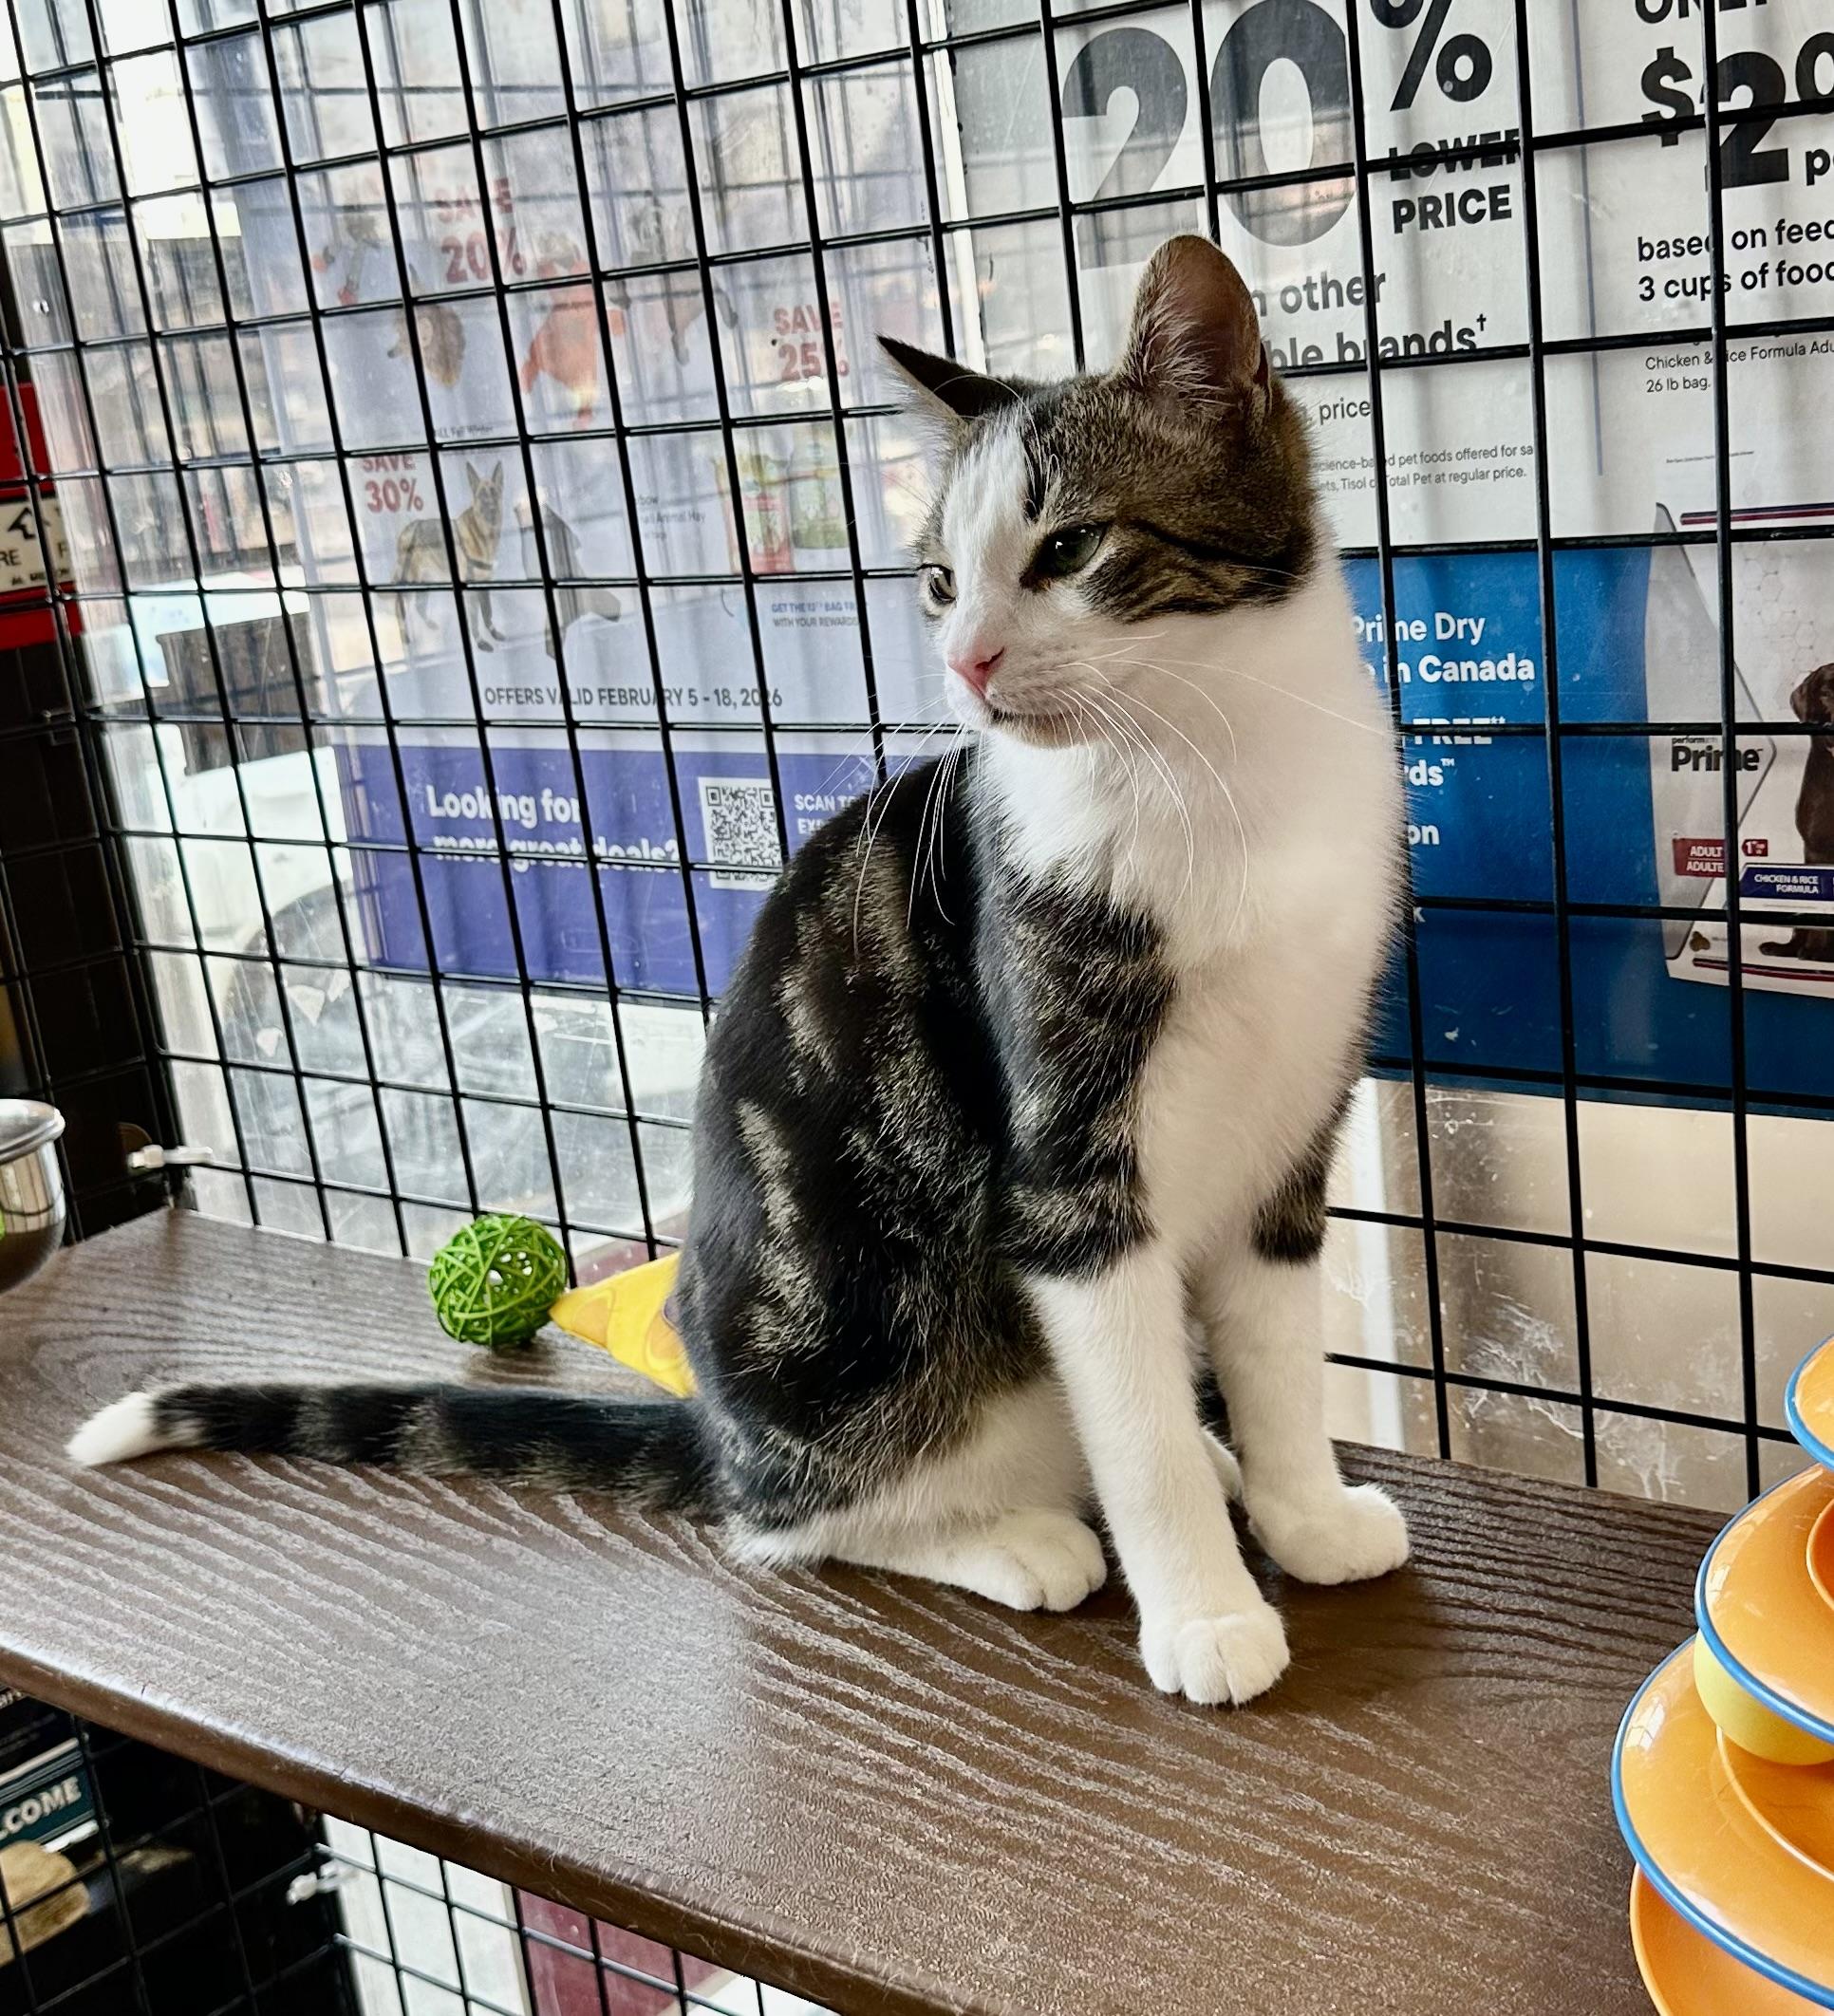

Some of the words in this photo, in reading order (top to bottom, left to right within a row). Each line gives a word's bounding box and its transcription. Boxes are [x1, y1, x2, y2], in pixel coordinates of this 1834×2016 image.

[435, 177, 513, 224] SAE
[1393, 184, 1512, 233] PRICE
[1731, 228, 1767, 251] on
[1281, 271, 1386, 314] other
[1638, 275, 1655, 302] 3
[1664, 272, 1731, 302] cups
[1740, 262, 1769, 290] of
[1645, 352, 1700, 370] Chicken
[1704, 351, 1713, 364] &
[1723, 348, 1747, 363] ice
[1750, 342, 1806, 360] Formula
[1646, 379, 1663, 393] 26
[1667, 378, 1679, 391] lb
[1319, 397, 1372, 425] price
[363, 452, 417, 473] SAVE
[1398, 454, 1417, 468] pet
[1420, 449, 1453, 464] foods
[1455, 446, 1498, 462] offered
[1501, 444, 1519, 457] for
[1340, 476, 1366, 491] Tisol
[1413, 472, 1433, 485] Pet
[1434, 473, 1447, 484] at
[1448, 467, 1490, 485] regular
[365, 477, 424, 513] 30%
[1434, 611, 1486, 646] Dry
[1383, 655, 1412, 683] in
[1418, 652, 1535, 683] Canada
[485, 687, 544, 706] OFFERS
[687, 687, 699, 706] 5
[714, 688, 738, 710] 18,
[741, 688, 783, 708] 206
[427, 784, 537, 830] Lookng
[541, 787, 582, 824] for
[794, 793, 835, 812] SCAN
[1689, 845, 1724, 858] ADULT
[1685, 861, 1726, 873] ADULTE
[1754, 873, 1792, 885] CHICKEN
[1776, 884, 1819, 894] FORMULA
